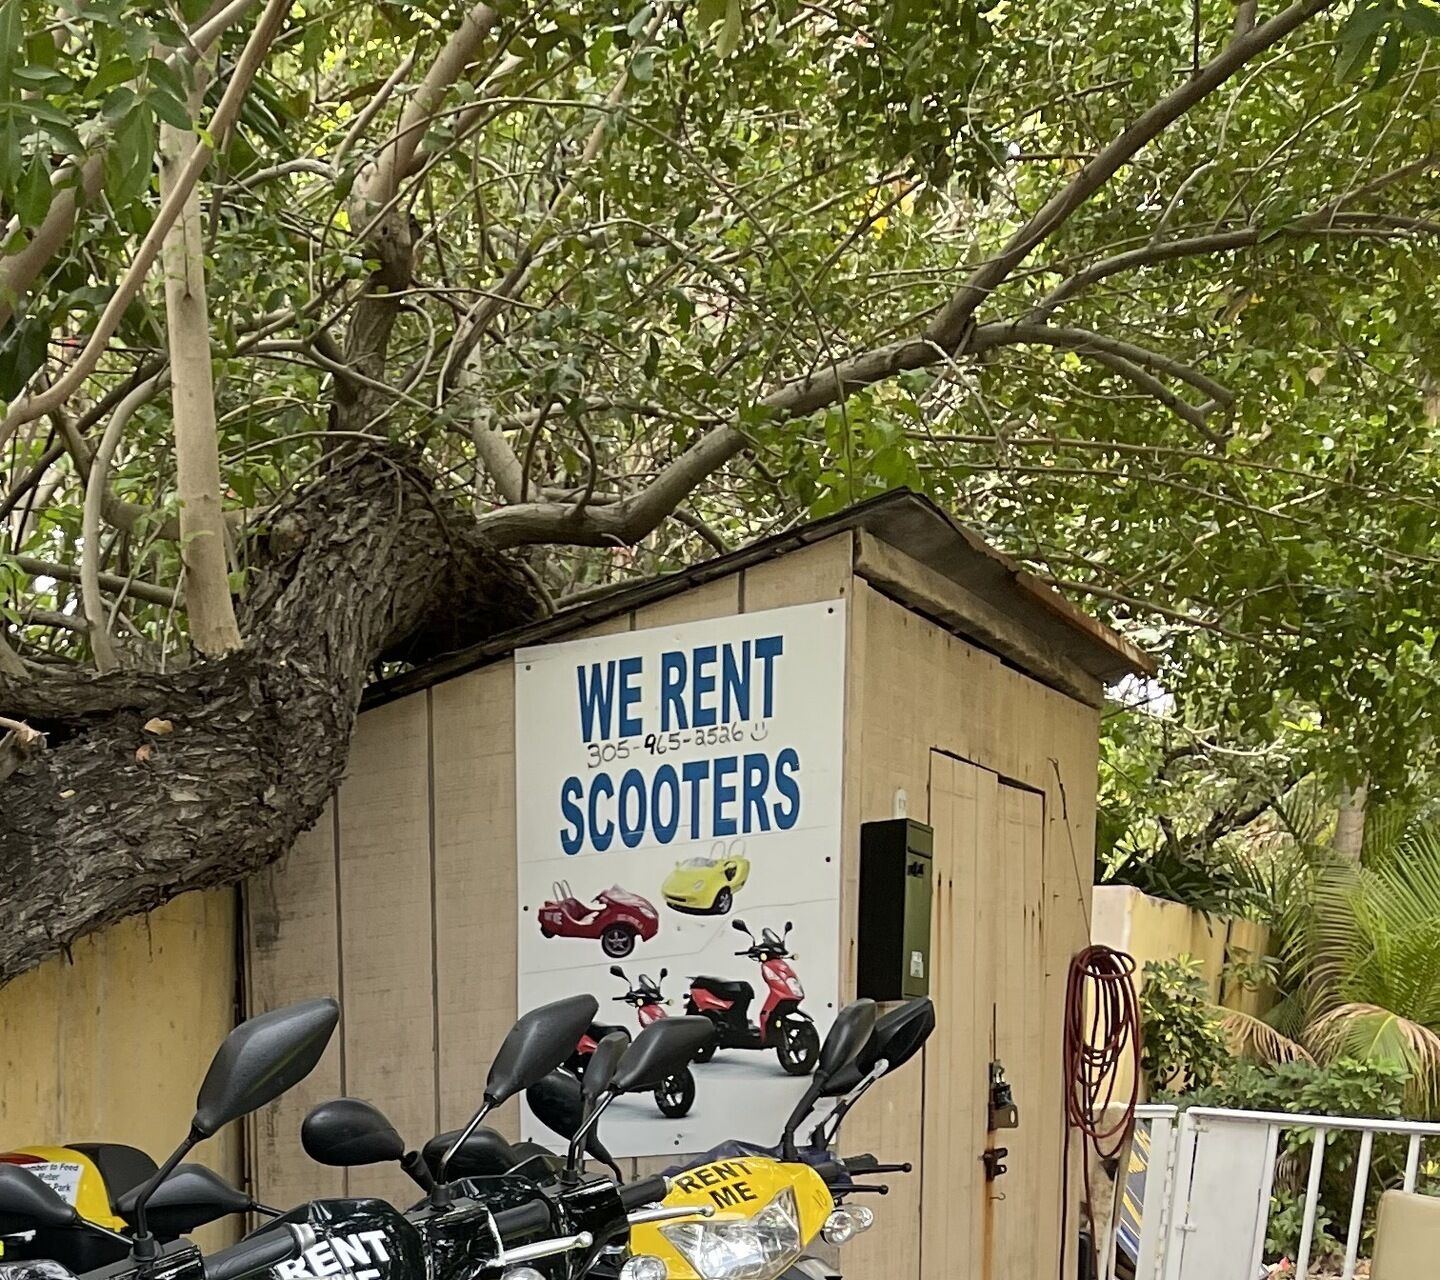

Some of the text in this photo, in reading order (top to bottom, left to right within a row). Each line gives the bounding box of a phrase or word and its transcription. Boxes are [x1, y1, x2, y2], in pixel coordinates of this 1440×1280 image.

[576, 634, 784, 743] WE RENT
[586, 721, 744, 769] 305-965-2526
[560, 747, 801, 856] SCOOTERS
[60, 1163, 79, 1171] Feed
[675, 1160, 753, 1194] RENT
[708, 1181, 759, 1209] ME
[273, 1229, 391, 1280] RENT
